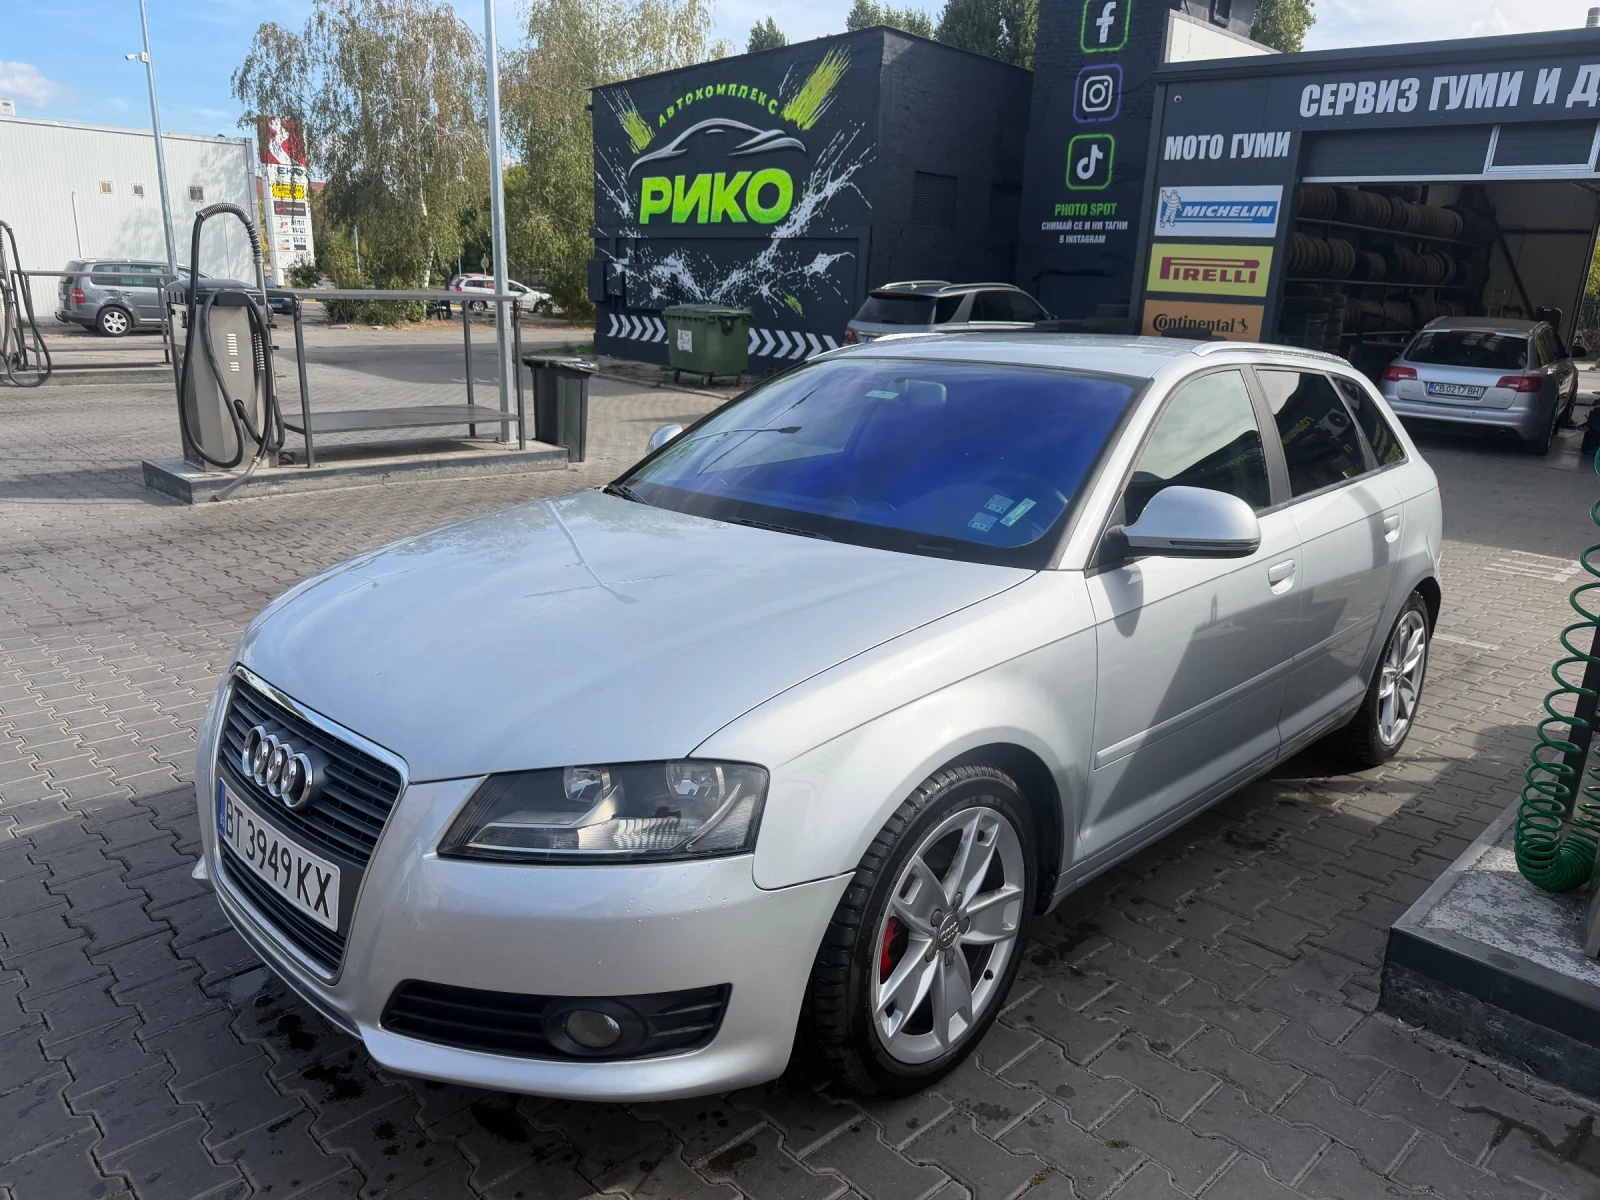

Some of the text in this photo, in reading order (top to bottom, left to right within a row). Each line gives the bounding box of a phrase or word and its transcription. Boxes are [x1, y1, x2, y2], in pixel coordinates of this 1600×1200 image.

[1300, 63, 1600, 117] СЕРВИЗ ГУМИ И Д
[658, 83, 779, 128] АВТОКОМПЛЕКС
[1163, 131, 1291, 160] МОТО ГУМИ
[639, 168, 794, 225] РИКО
[1054, 202, 1118, 216] PHOTO SPOT
[1181, 205, 1274, 218] MICHELIN
[1041, 220, 1072, 230] СНИМАЙ
[1073, 221, 1083, 230] СЕ
[1104, 221, 1128, 230] ТАГНИ
[1065, 234, 1106, 244] INSTAGRAM
[1159, 256, 1260, 284] PIRELLI
[1152, 313, 1235, 332] Continental
[1446, 385, 1467, 394] 0217
[226, 795, 332, 919] BT 3949 KX
